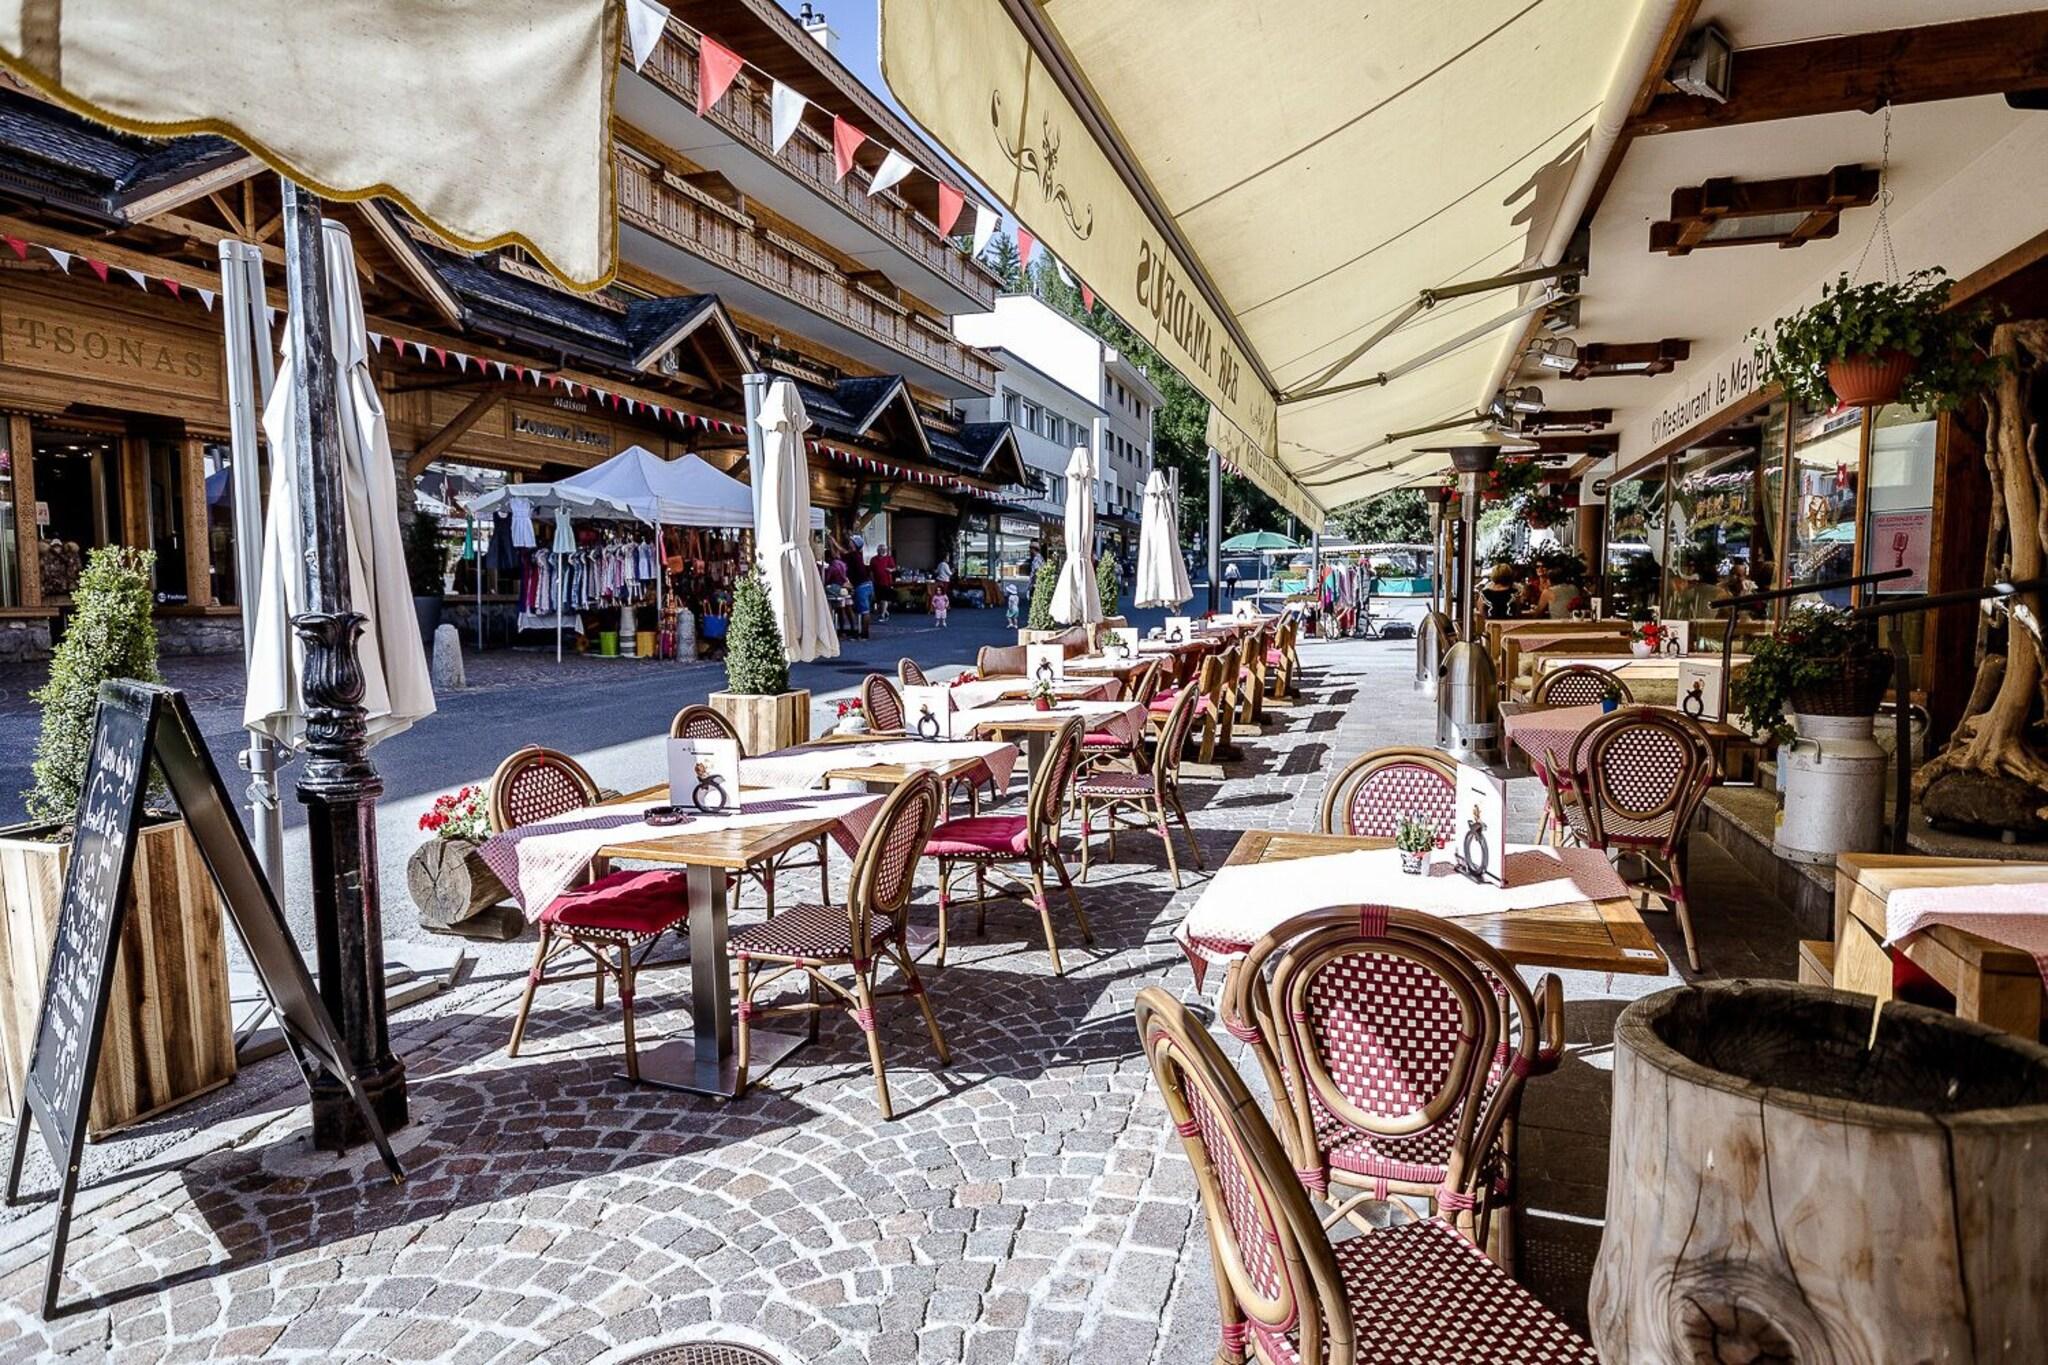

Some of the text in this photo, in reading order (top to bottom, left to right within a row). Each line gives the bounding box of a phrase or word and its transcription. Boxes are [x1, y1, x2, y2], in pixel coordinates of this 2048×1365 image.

[17, 317, 204, 378] TSONAS
[553, 397, 588, 413] Maison
[1661, 380, 1712, 440] Restaurant
[1715, 372, 1727, 406] le
